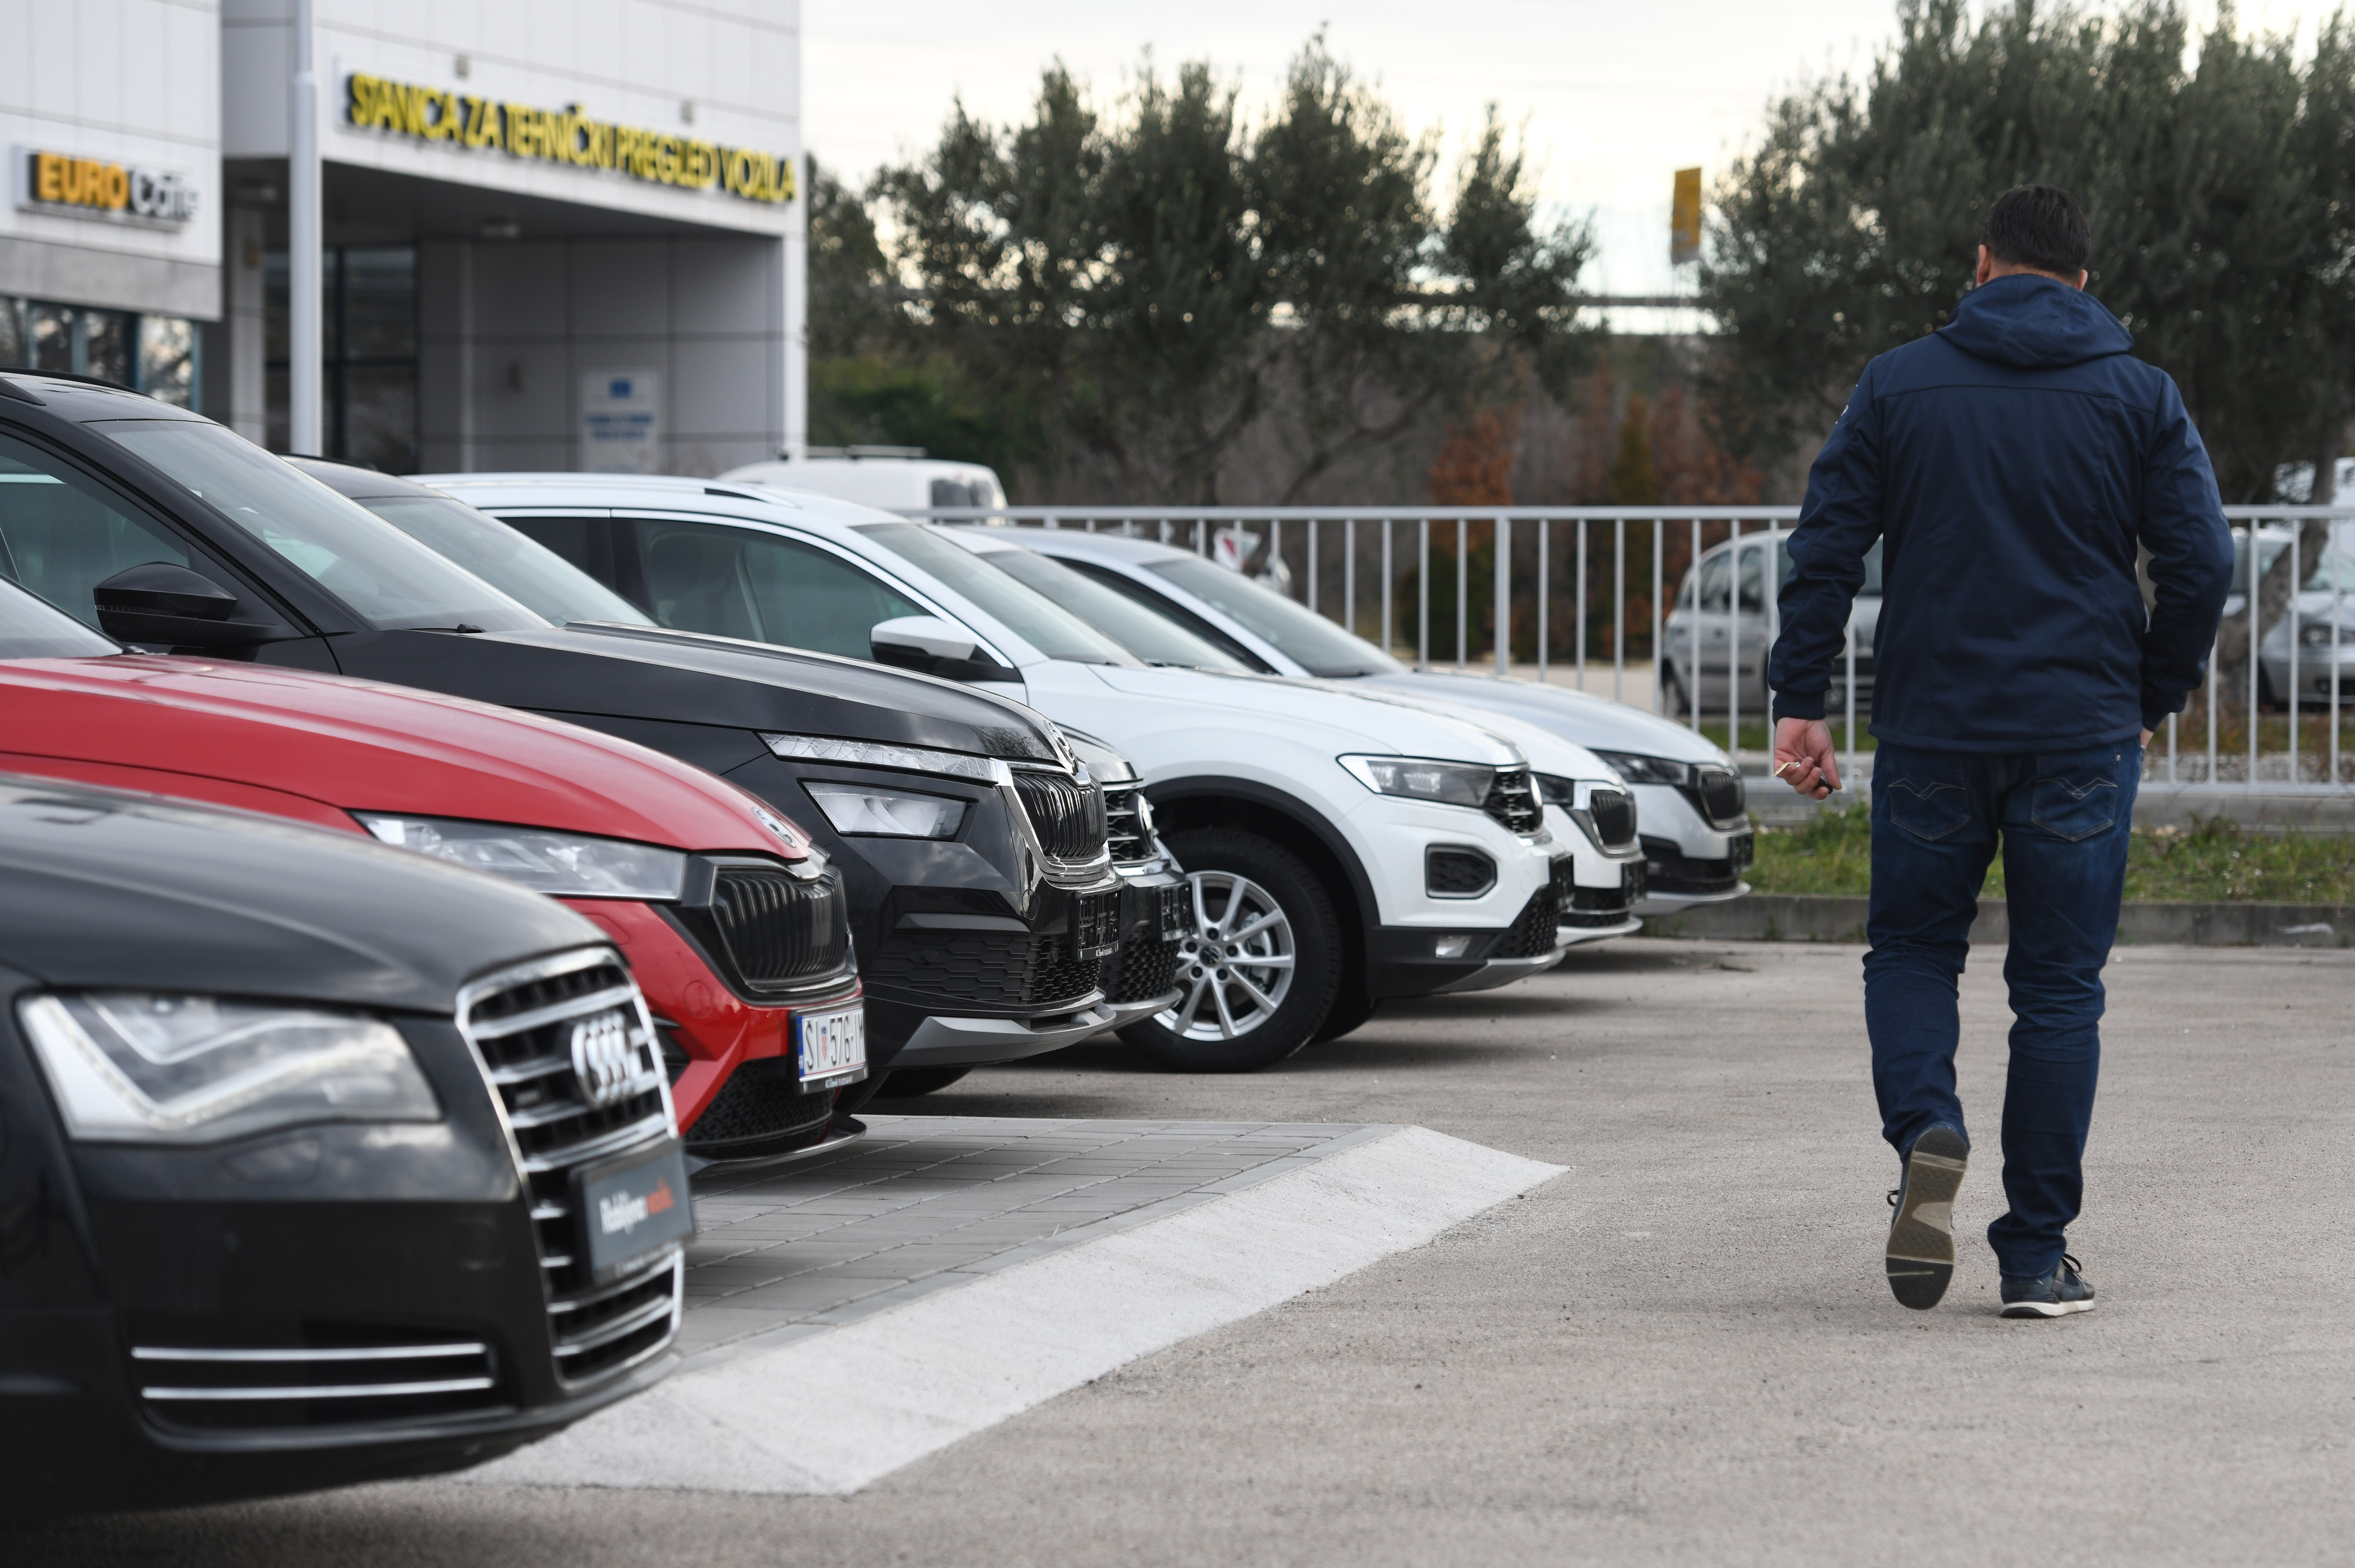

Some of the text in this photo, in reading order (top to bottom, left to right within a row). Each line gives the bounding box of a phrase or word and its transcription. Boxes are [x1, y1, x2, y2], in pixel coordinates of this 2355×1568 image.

[37, 151, 130, 210] EURO
[351, 73, 466, 145] STANICA
[465, 94, 505, 150] ZA
[616, 124, 720, 189] PREGLED
[719, 144, 795, 202] VOZILA
